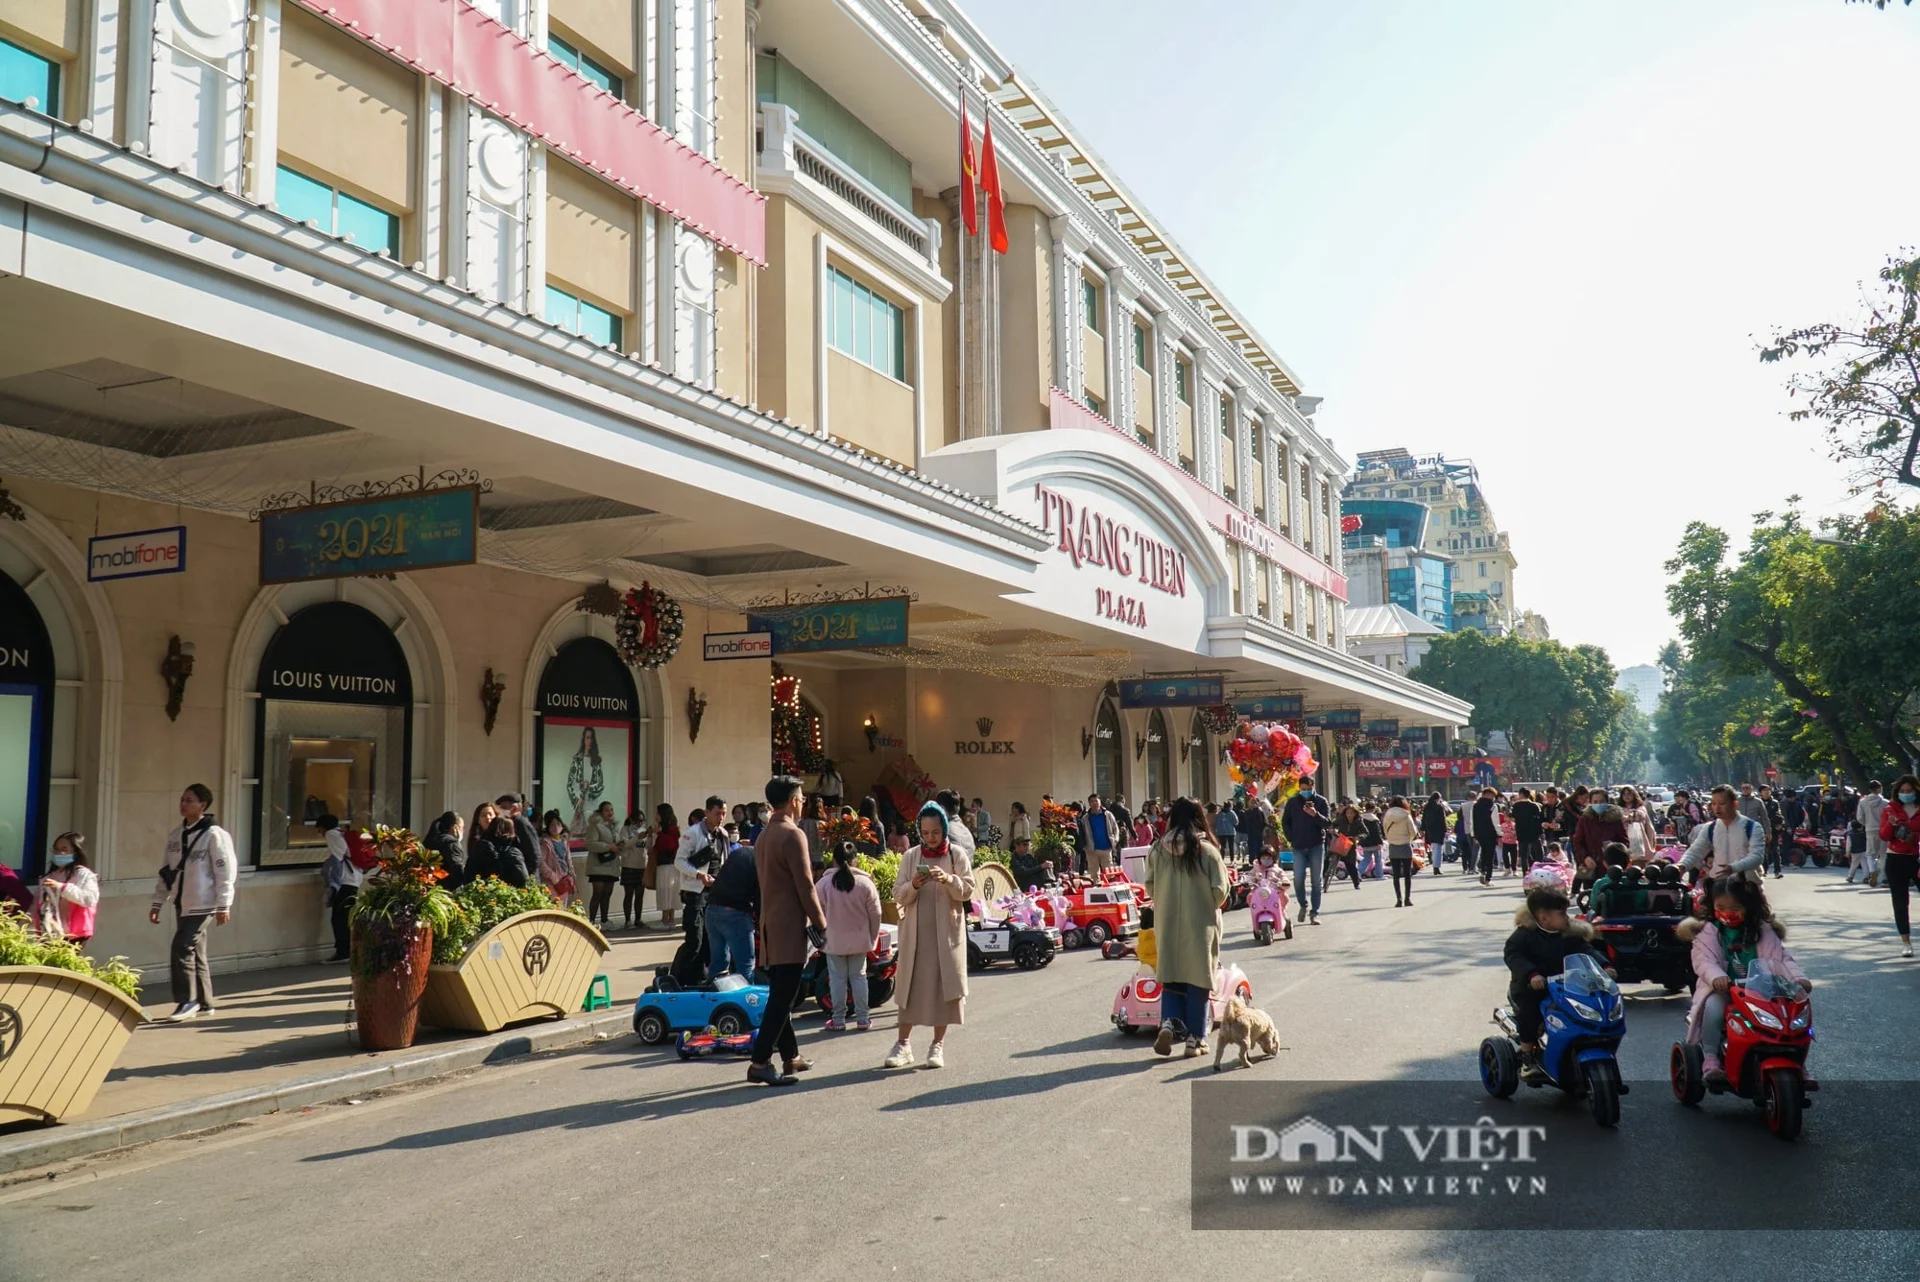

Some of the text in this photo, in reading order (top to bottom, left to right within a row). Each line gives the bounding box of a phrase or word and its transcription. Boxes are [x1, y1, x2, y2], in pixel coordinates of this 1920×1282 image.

[316, 514, 408, 561] 2021
[1035, 483, 1187, 598] TRANG TIEN
[92, 543, 179, 569] mobifone
[1096, 587, 1148, 628] PLAZA
[792, 613, 859, 642] 2021
[706, 639, 770, 653] mobifone
[273, 670, 396, 694] LOUIS VUITTON
[547, 693, 628, 711] LOUIS VUITTON
[1096, 723, 1113, 739] Cartier
[954, 741, 1016, 754] ROLEX
